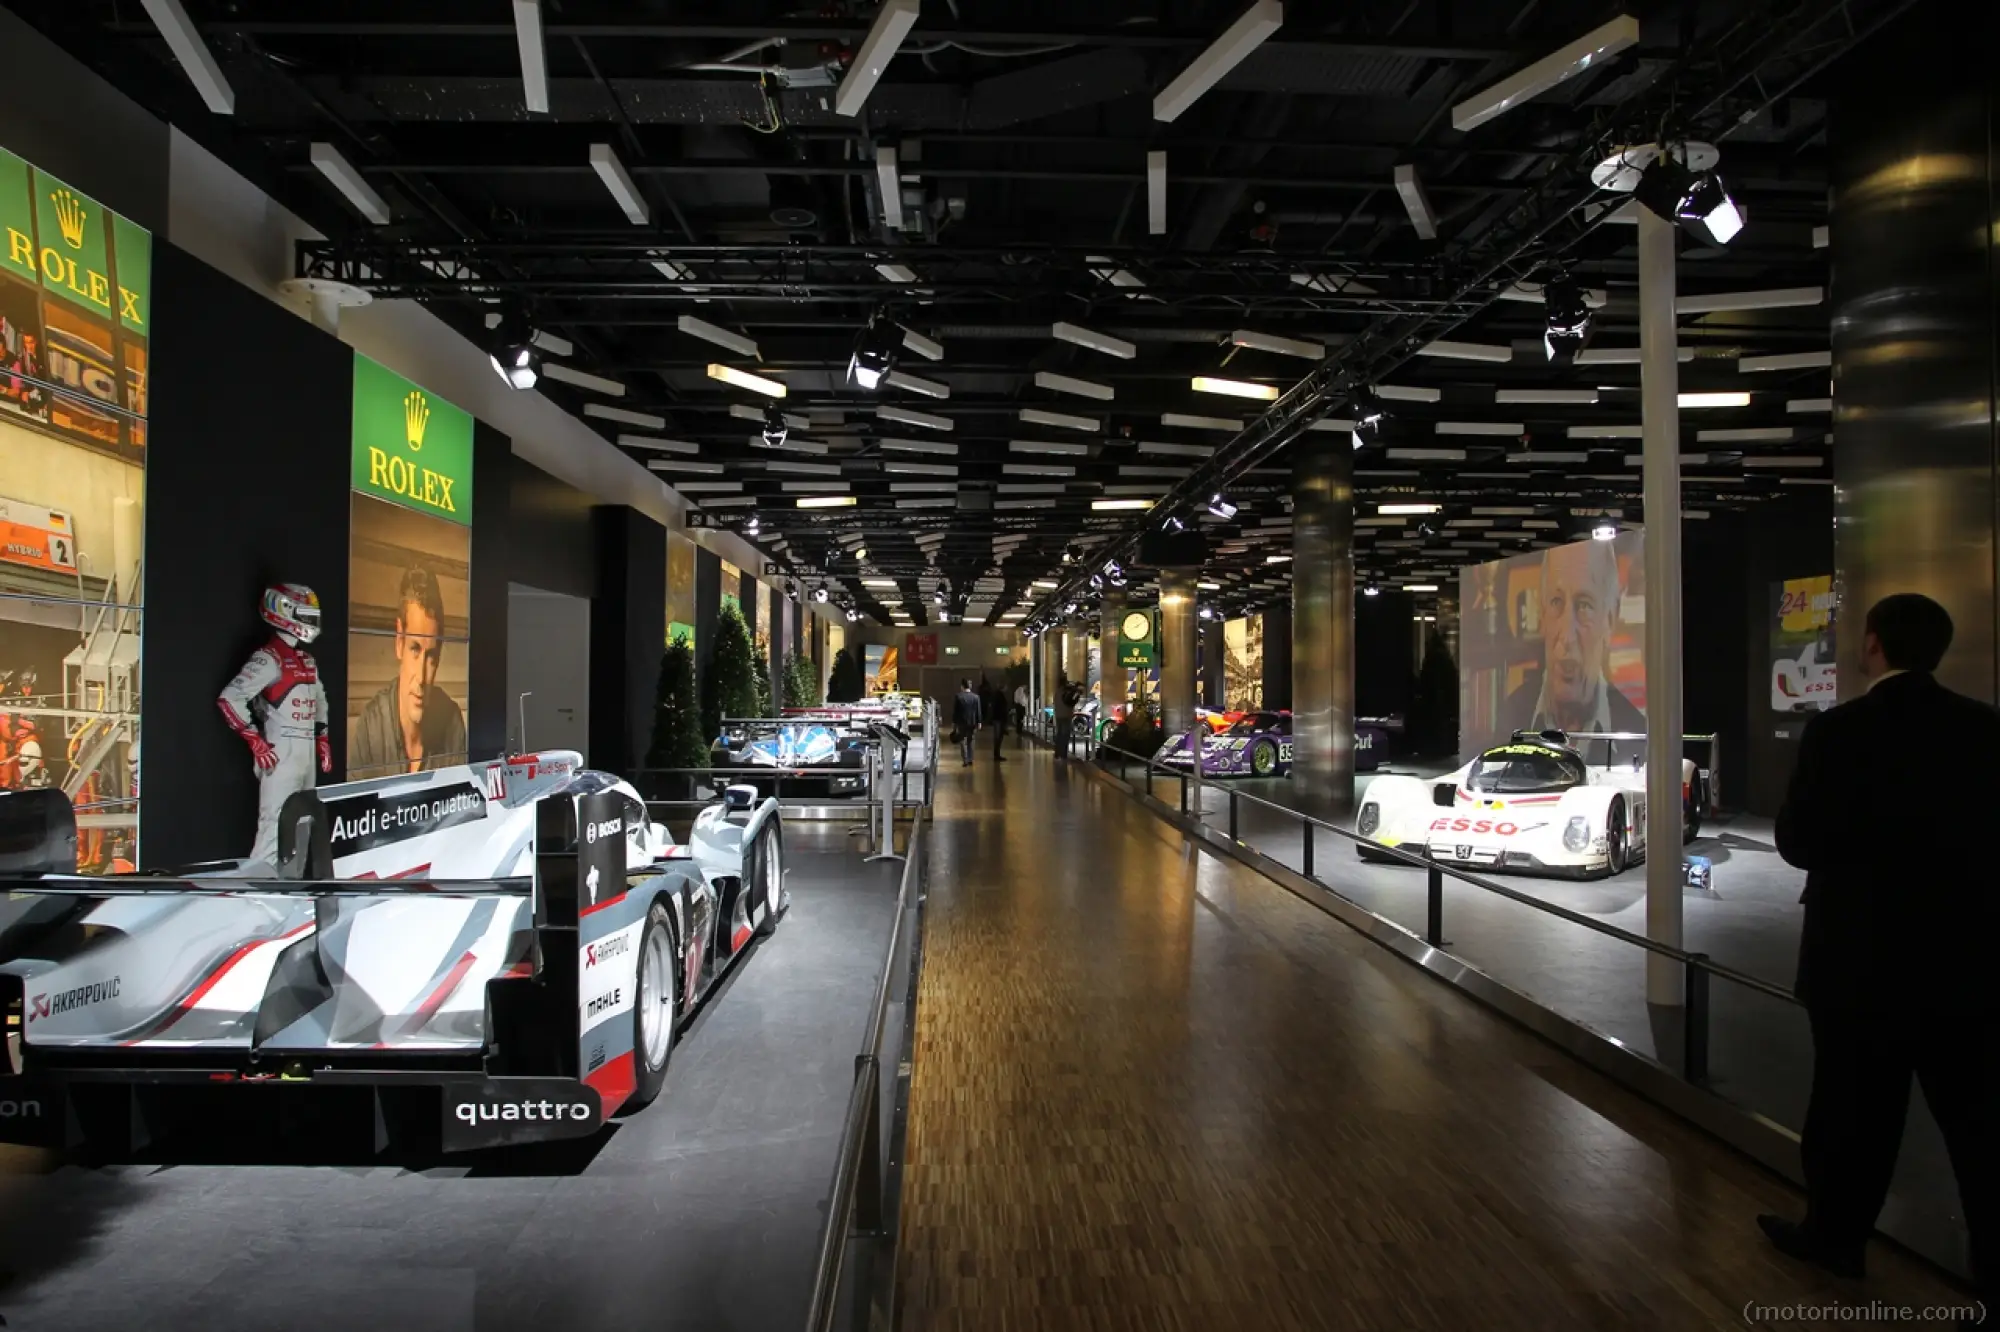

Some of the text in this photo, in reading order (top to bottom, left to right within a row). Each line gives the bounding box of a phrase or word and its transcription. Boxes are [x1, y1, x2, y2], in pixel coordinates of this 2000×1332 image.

[6, 226, 143, 324] ROLEX
[368, 446, 456, 512] ROLEX
[56, 540, 68, 563] 2
[1778, 591, 1808, 617] 24
[330, 791, 480, 843] Audi e-tron quattro
[598, 817, 621, 838] BOSCH
[1429, 817, 1519, 836] ESSO
[587, 987, 621, 1018] MAHLE
[455, 1099, 591, 1127] quattro
